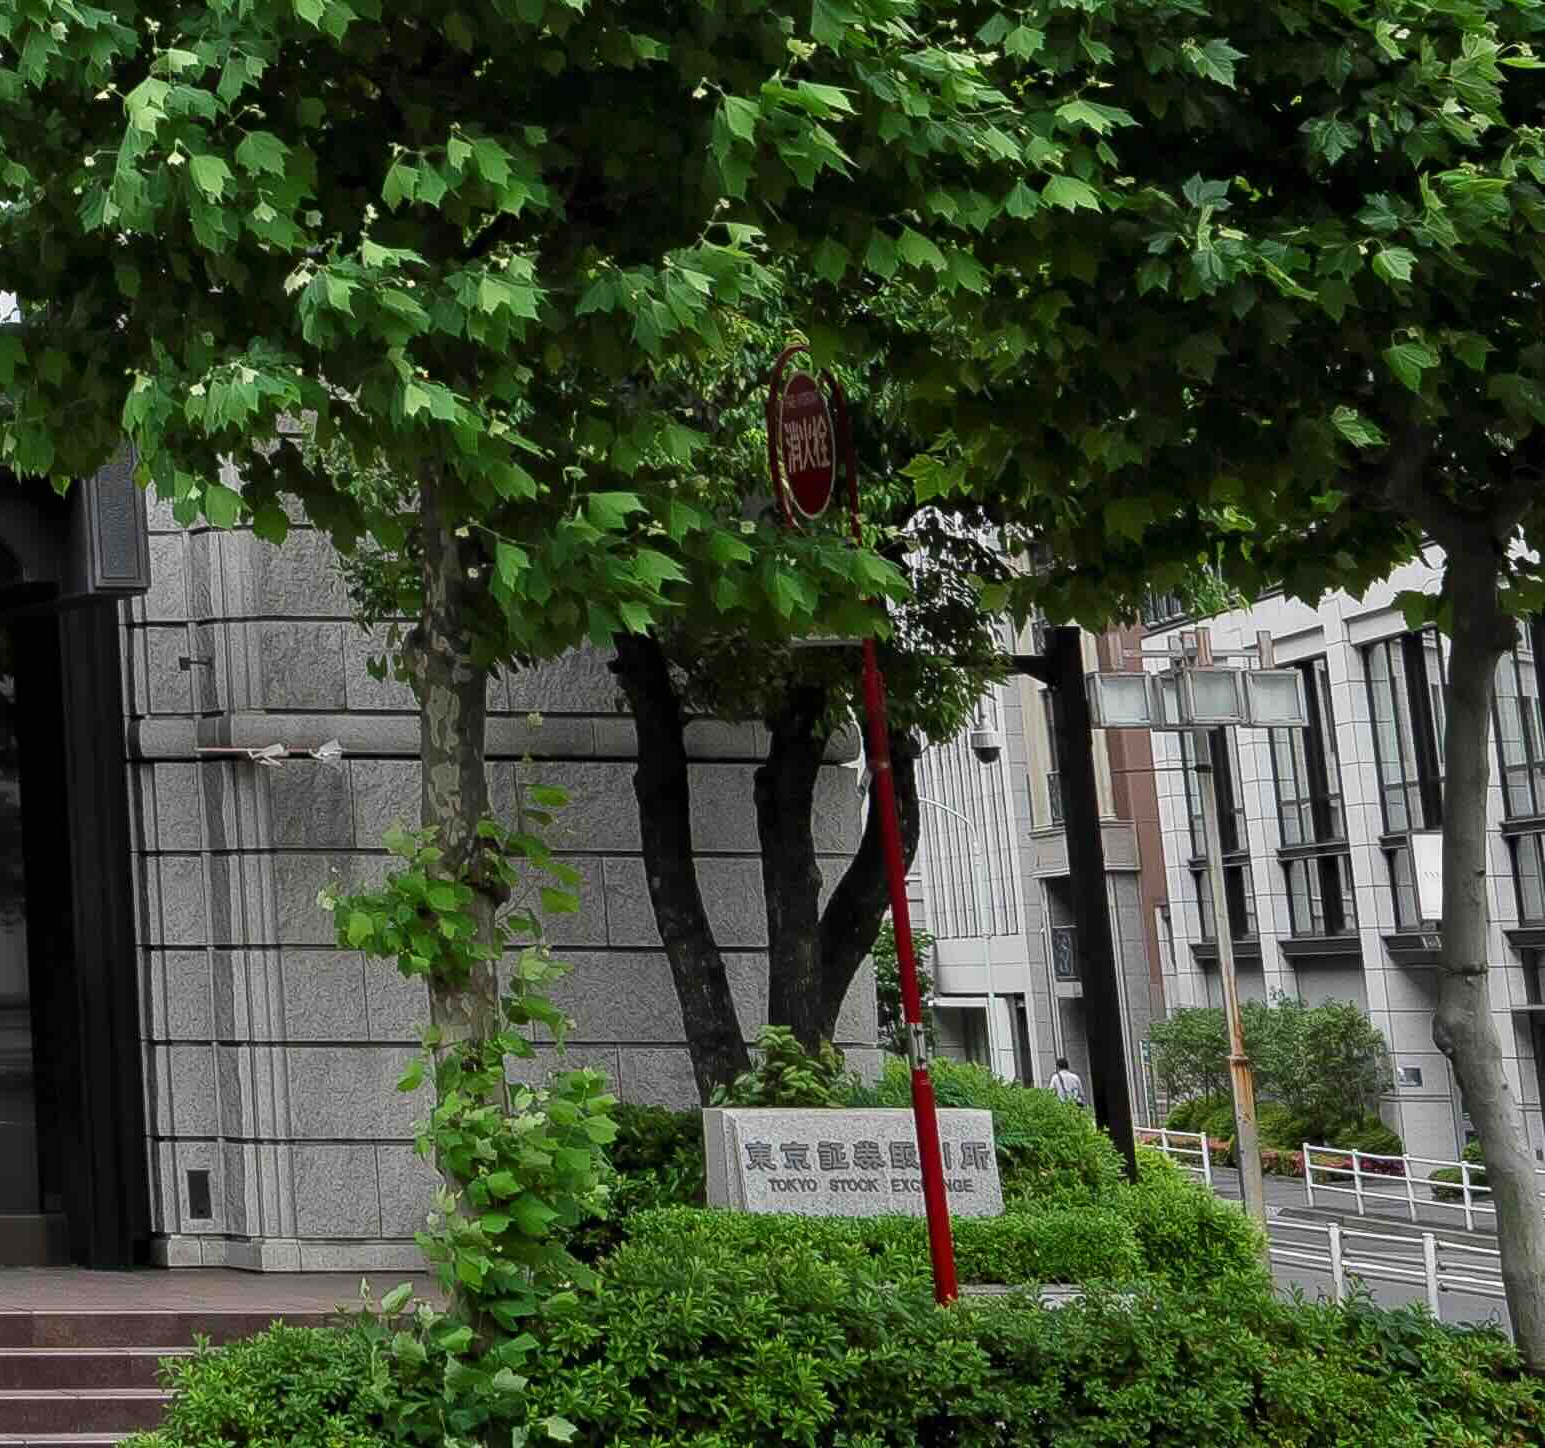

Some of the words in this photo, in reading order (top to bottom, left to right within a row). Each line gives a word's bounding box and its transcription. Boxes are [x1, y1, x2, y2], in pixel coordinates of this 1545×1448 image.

[745, 1141, 991, 1171] 東京証券取所
[768, 1178, 818, 1193] TOKYO
[829, 1178, 880, 1193] STOCK
[891, 1178, 975, 1193] EXCNGE
